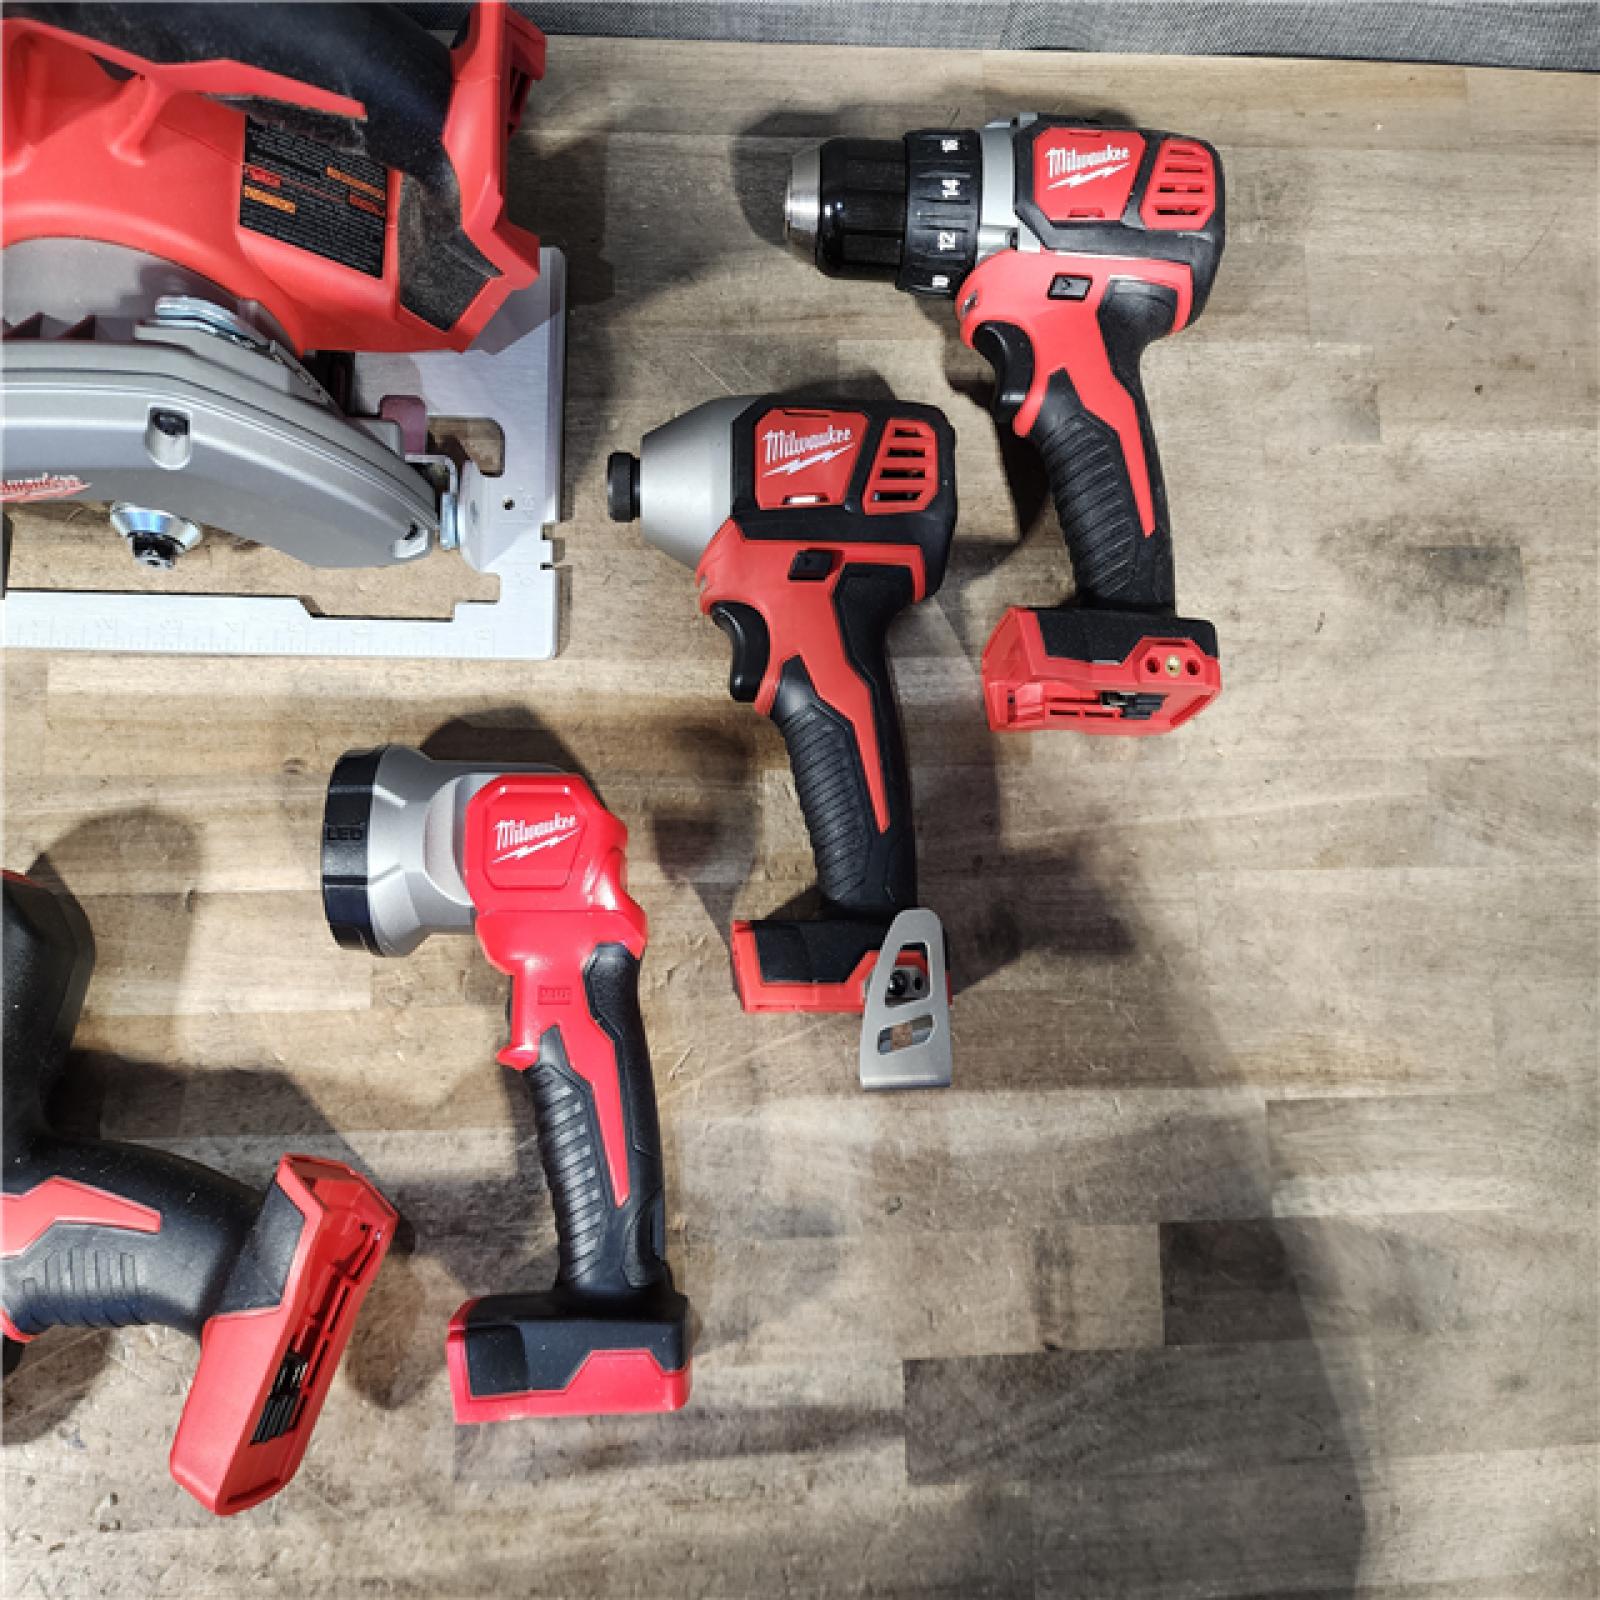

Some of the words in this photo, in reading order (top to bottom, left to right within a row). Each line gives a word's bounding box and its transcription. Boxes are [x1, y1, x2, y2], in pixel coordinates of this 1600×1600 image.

[1046, 144, 1130, 178] Milwaukee
[941, 179, 960, 198] 14
[938, 231, 956, 251] 12
[762, 425, 852, 464] Milwaukee
[492, 812, 577, 851] Milwaukee
